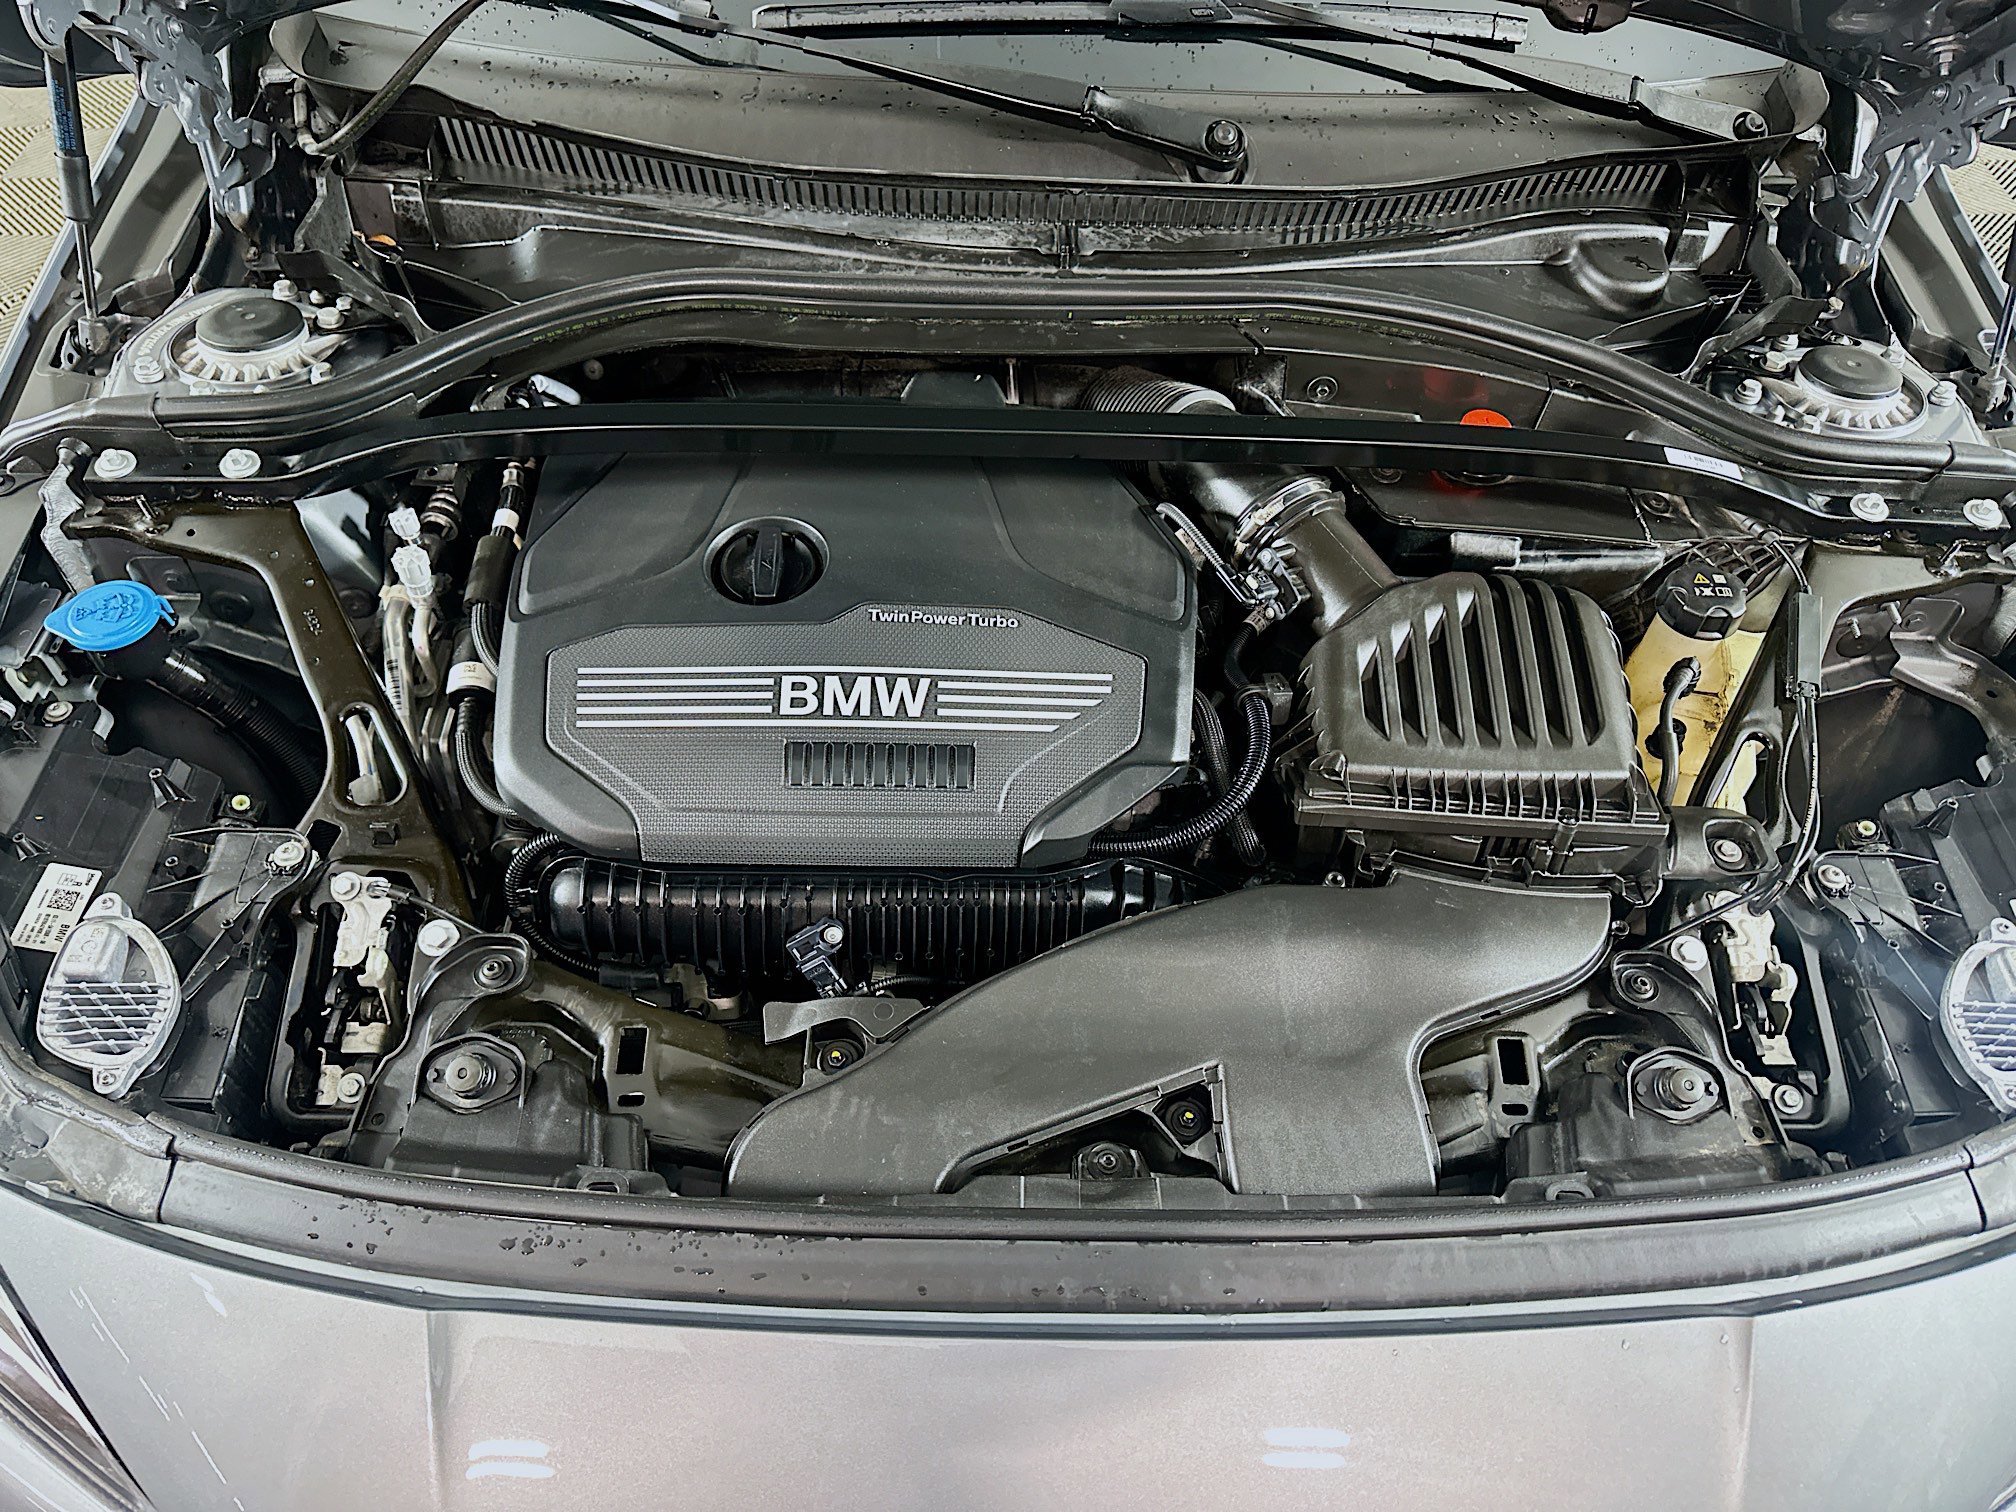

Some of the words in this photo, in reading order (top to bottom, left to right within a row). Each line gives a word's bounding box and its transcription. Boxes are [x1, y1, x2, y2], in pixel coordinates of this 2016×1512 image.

[868, 608, 967, 626] TwinPower
[967, 613, 1019, 628] Turbo
[779, 675, 931, 718] BMW
[54, 924, 71, 942] BMW
